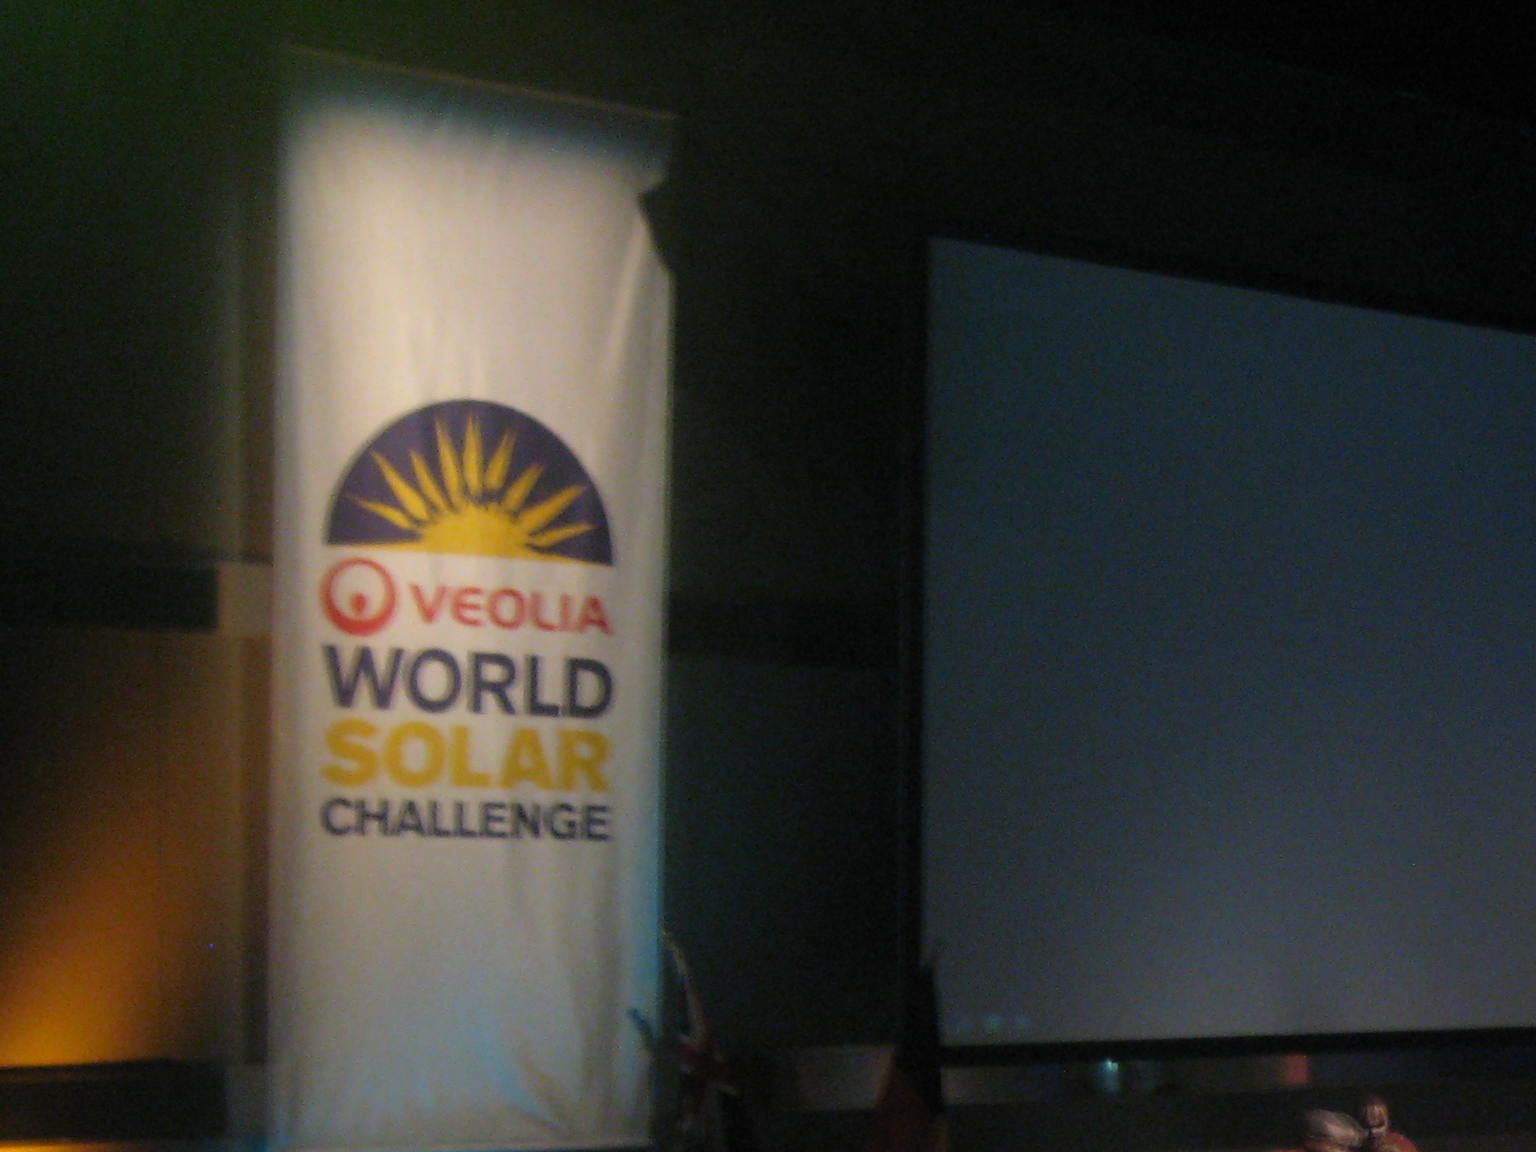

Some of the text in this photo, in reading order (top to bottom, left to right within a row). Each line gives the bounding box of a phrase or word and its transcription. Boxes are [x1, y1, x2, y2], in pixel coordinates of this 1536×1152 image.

[408, 582, 614, 636] VEOLIA
[322, 644, 614, 718] WORLD
[320, 717, 611, 793] SOLAR
[320, 796, 611, 841] CHALLENGE
